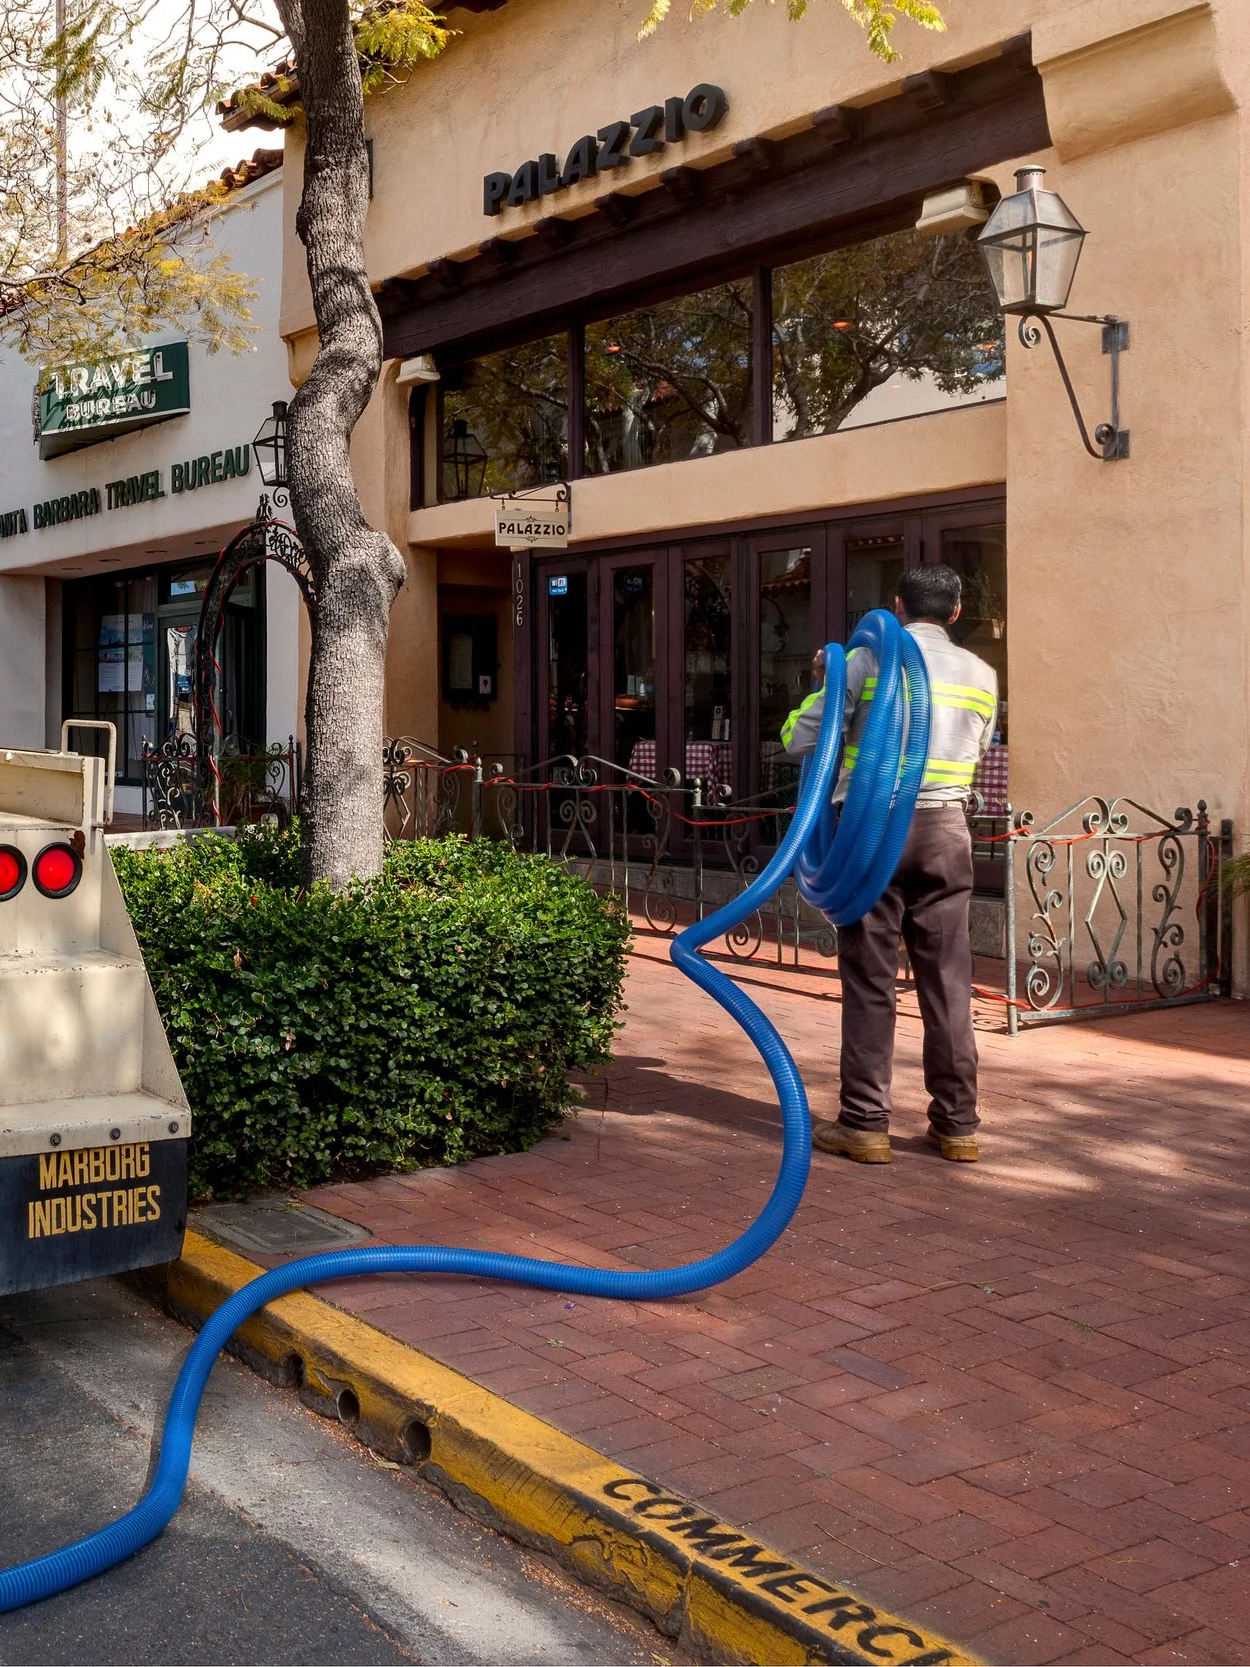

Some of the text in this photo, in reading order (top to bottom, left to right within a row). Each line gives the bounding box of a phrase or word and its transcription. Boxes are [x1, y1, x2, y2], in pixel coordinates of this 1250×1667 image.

[483, 83, 729, 217] PALAZZIO
[51, 352, 173, 400] TRAVEL
[66, 389, 156, 421] BUREAU
[33, 487, 100, 531] BARBARA
[105, 470, 166, 511] TRAVEL
[171, 444, 250, 494] BUREAU
[499, 522, 566, 535] PALAZZIO
[516, 562, 524, 626] 1026
[39, 1142, 150, 1190] MARBORG
[28, 1185, 161, 1239] INDUSTRIES
